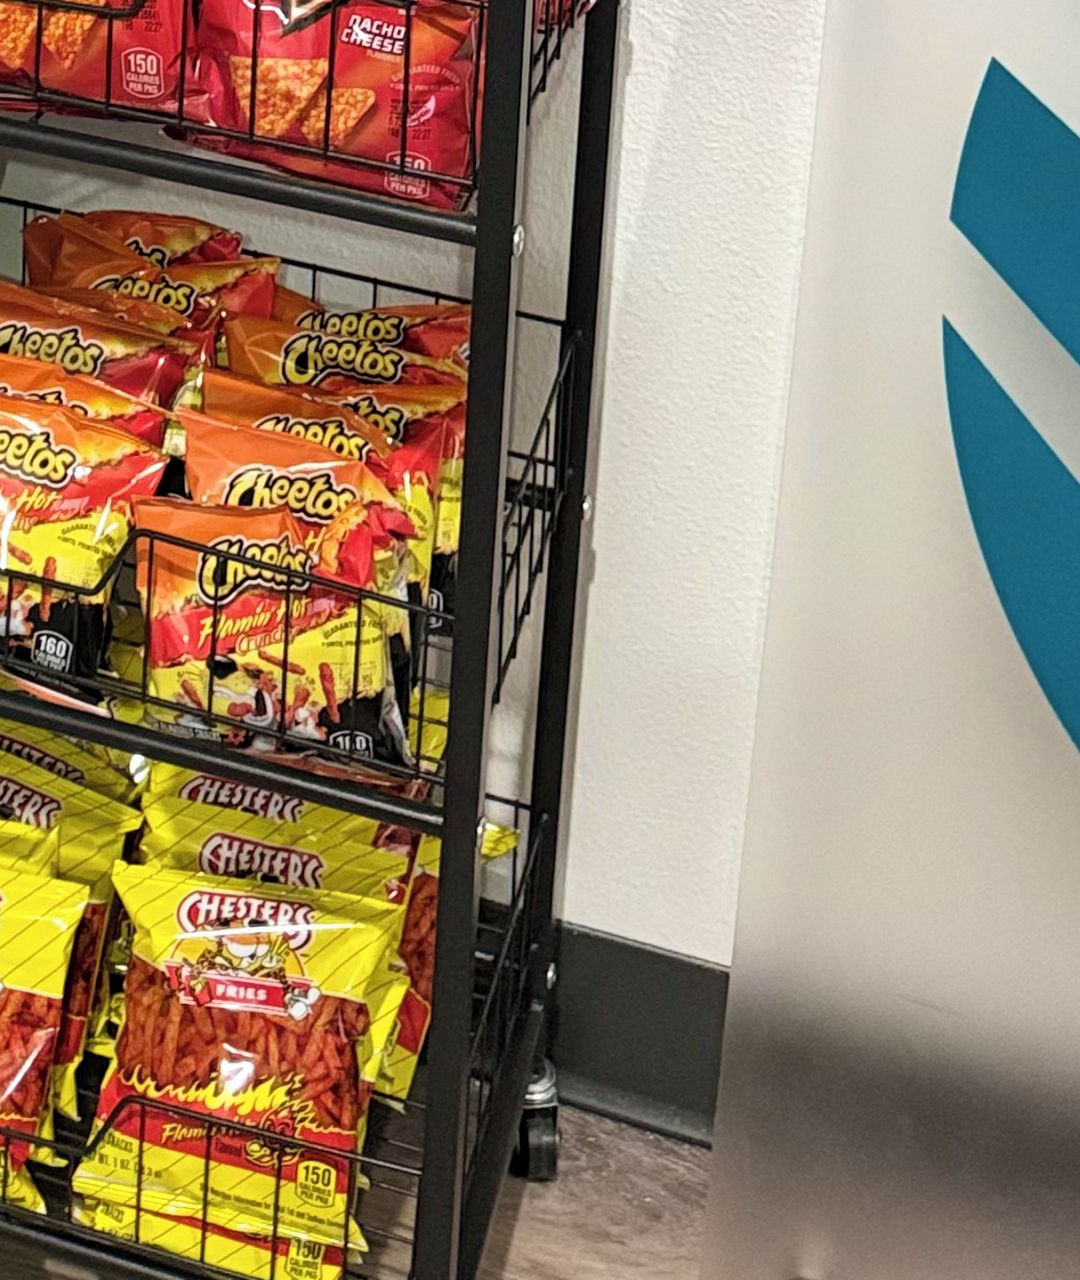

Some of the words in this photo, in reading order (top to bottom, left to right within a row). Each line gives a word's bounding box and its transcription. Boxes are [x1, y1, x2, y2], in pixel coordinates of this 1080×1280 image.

[348, 14, 406, 41] NACHO
[340, 29, 405, 55] CHEESE
[128, 54, 157, 74] 150
[126, 72, 160, 84] CALORIES
[128, 82, 142, 92] PER
[282, 332, 405, 385] Cheetos
[225, 468, 358, 522] Cheetos
[38, 633, 67, 657] 160
[179, 891, 315, 944] CHESTER'S
[216, 985, 267, 1002] FRIES
[303, 1165, 332, 1187] 150
[299, 1182, 332, 1197] CALORIES
[301, 1191, 313, 1202] PER
[314, 1193, 329, 1205] PKG
[295, 1239, 320, 1259] 150
[289, 1257, 319, 1271] CALORIES
